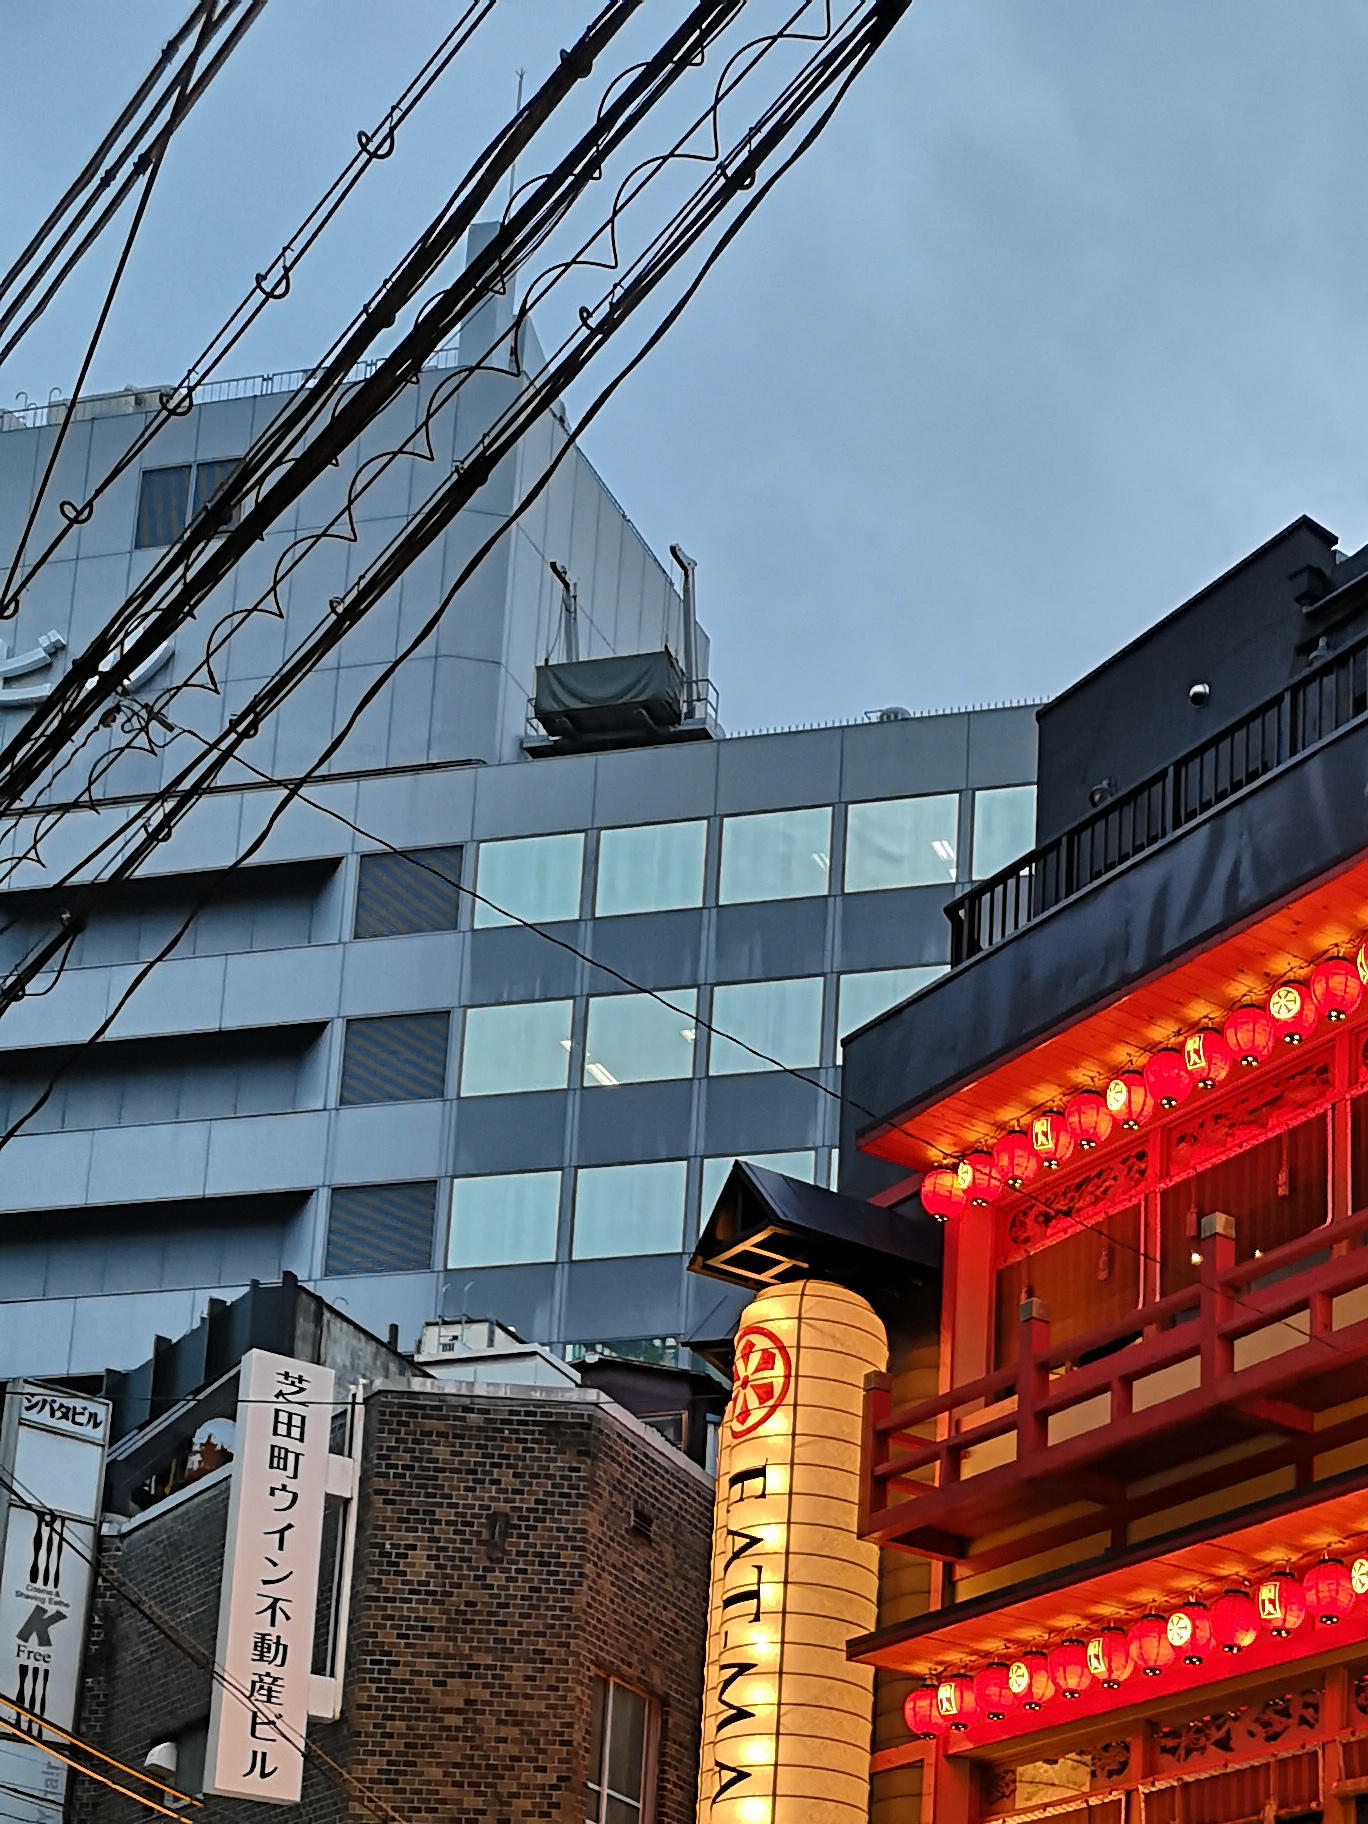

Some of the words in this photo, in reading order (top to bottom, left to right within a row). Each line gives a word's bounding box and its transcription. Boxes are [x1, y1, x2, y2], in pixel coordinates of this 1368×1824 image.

[16, 1643, 52, 1663] Free
[242, 1370, 311, 1780] 芝田町ウイン不動産ビル
